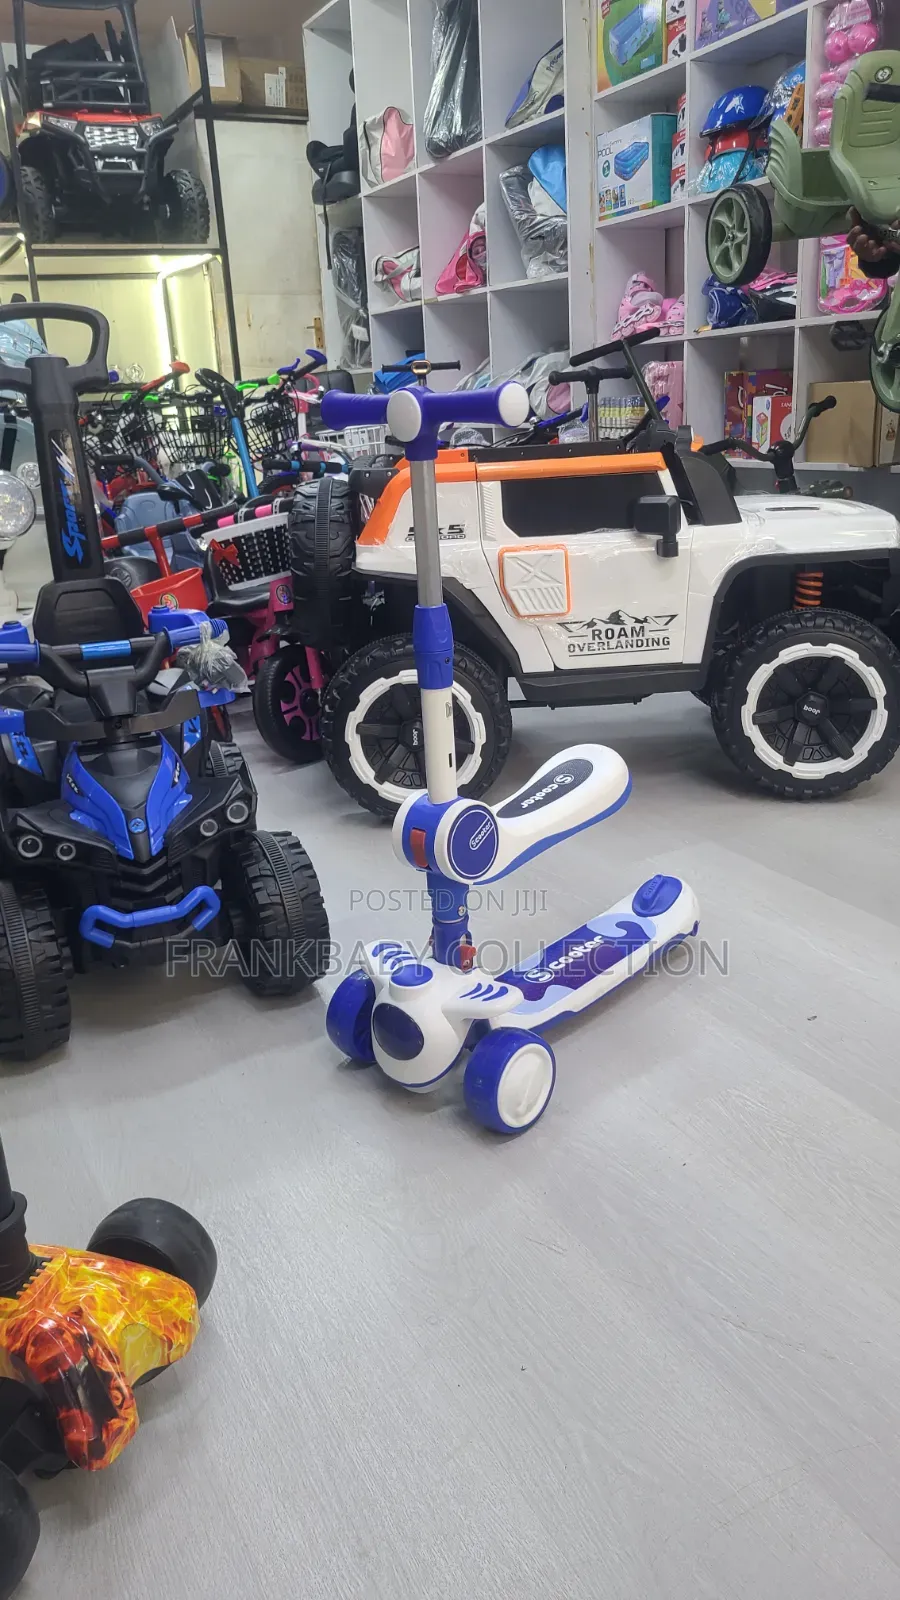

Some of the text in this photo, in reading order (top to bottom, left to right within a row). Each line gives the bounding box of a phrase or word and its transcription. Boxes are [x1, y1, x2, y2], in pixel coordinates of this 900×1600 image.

[592, 625, 645, 641] ROAM
[568, 636, 670, 653] OVERLANDING
[471, 821, 491, 848] Scooter
